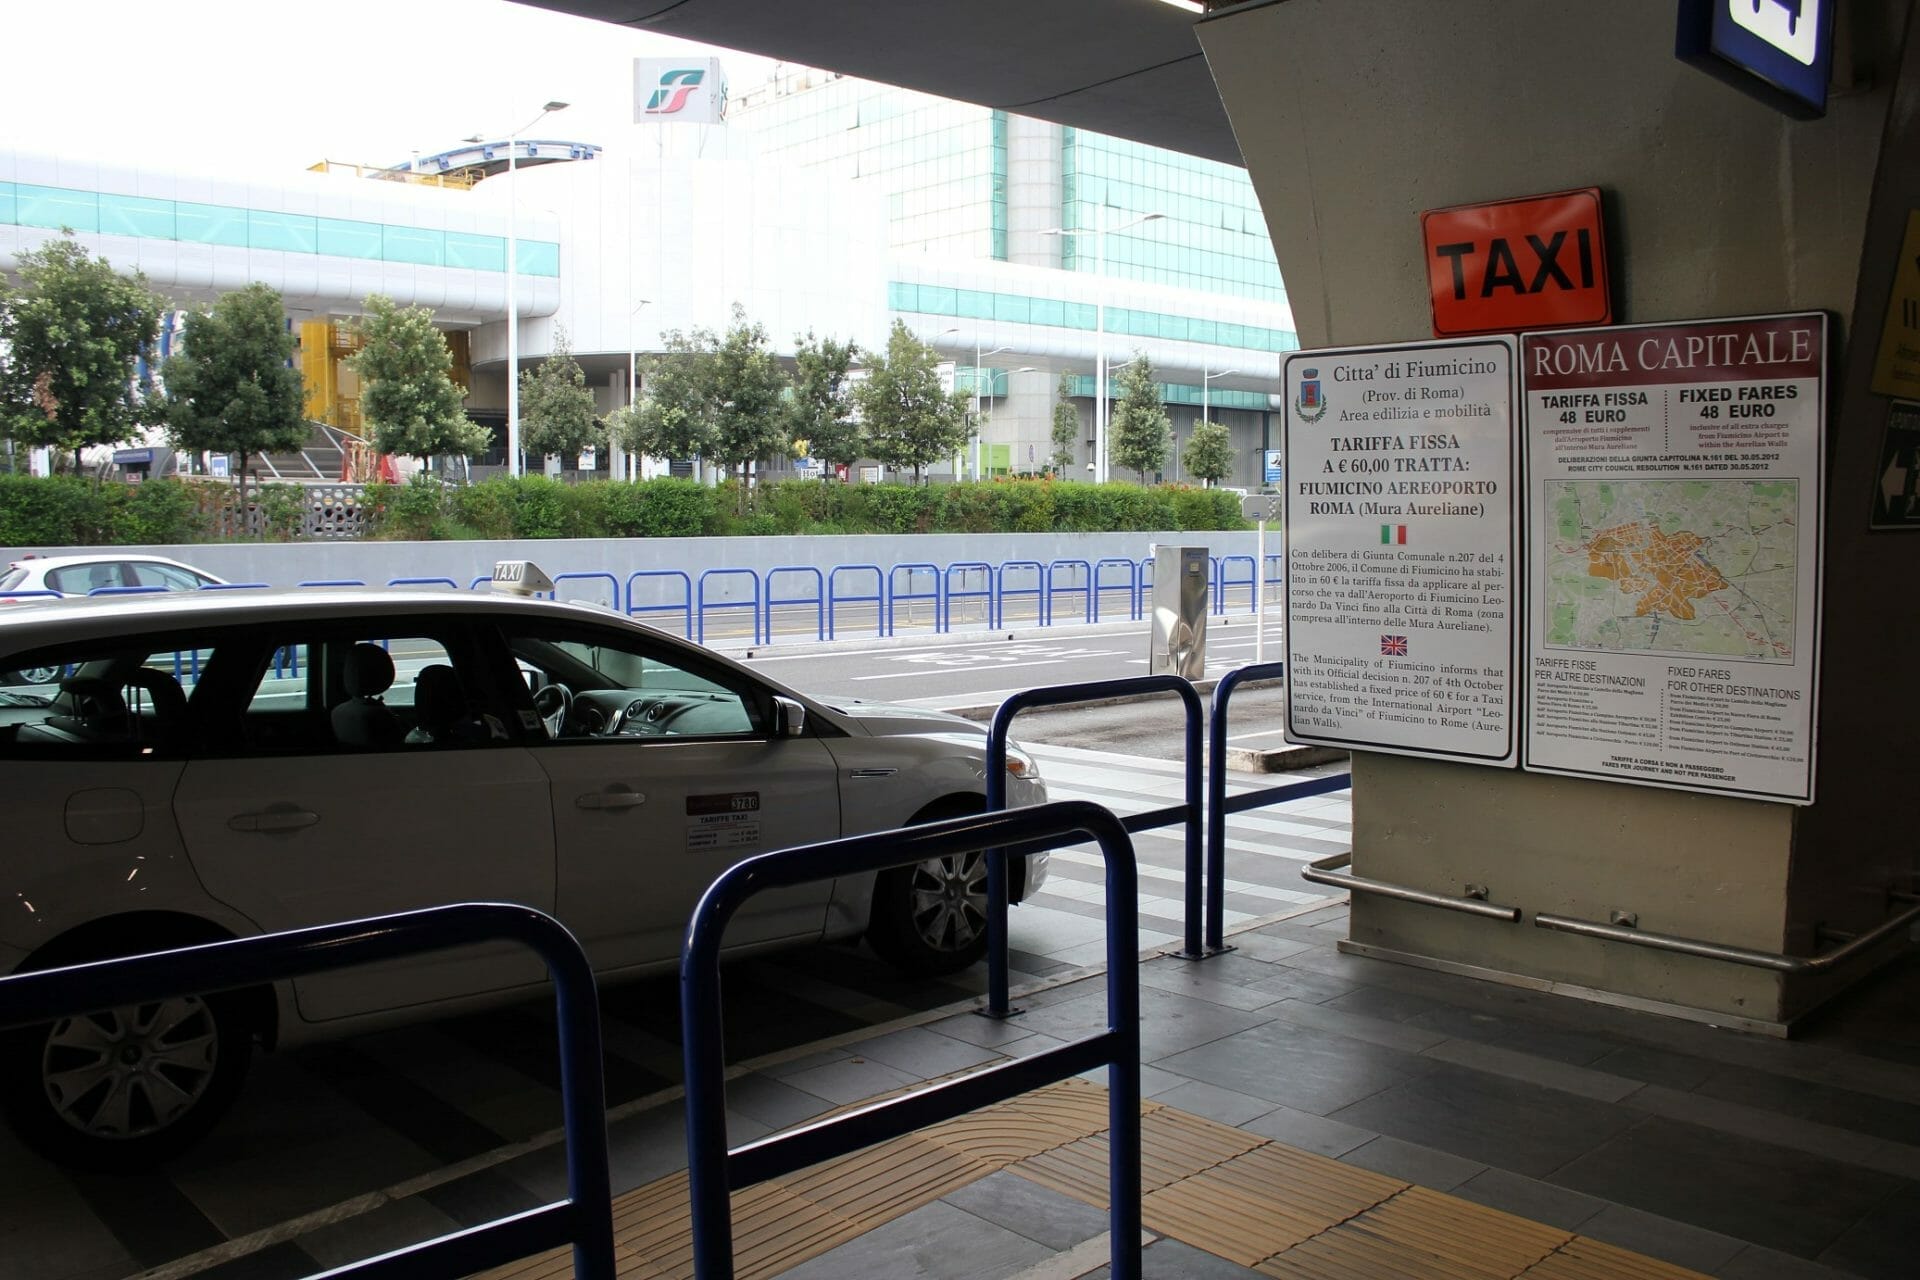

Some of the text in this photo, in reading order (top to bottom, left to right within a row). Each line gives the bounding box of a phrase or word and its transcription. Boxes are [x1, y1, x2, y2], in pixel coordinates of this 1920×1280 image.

[1436, 228, 1594, 301] TAXI
[1533, 330, 1811, 375] ROMA CAPITALE
[1384, 362, 1400, 378] di
[1405, 358, 1496, 377] Fiumicino
[1362, 386, 1464, 403] (Prov. di Roma)
[1541, 392, 1648, 408] TARIFFA FISSA
[1680, 385, 1797, 402] FIXED FARES
[1339, 403, 1491, 421] Area edilizia e mobilità
[1559, 409, 1626, 423] 48 EURO
[1700, 403, 1775, 418] 48 EURO
[1331, 434, 1460, 451] TARIFFA FISSA
[1322, 457, 1469, 474] A € 60,00 TRATTA:
[1300, 481, 1496, 494] FIUMICINO AEREOPORTO
[1310, 501, 1484, 517] ROMA (Mura Aureliane)
[1291, 548, 1503, 563] Con delibera di Giunta Comunale n.207 del 4
[495, 564, 522, 580] TAXI
[1291, 561, 1324, 571] Ottobre
[1326, 562, 1349, 572] 2006,
[1352, 563, 1357, 572] il
[1360, 563, 1397, 573] Comune
[1400, 564, 1408, 573] di
[1411, 565, 1459, 575] Fiumicino
[1462, 566, 1474, 575] ha
[1292, 574, 1306, 583] lito
[1309, 574, 1317, 583] in
[1320, 575, 1330, 584] 60
[1333, 575, 1338, 584] €
[1341, 575, 1349, 585] la
[1353, 576, 1381, 585] tariffa
[1384, 577, 1404, 586] fissa
[1408, 578, 1419, 587] da
[1422, 579, 1467, 590] applicare
[1471, 580, 1480, 590] al
[1316, 588, 1331, 597] che
[1417, 592, 1426, 601] di
[1430, 592, 1479, 603] Fiumicino
[1292, 600, 1503, 618] nardo Da Vinci fino alla Città di Roma (zona
[1292, 614, 1332, 623] compresa
[1383, 617, 1406, 626] delle
[1409, 618, 1434, 628] Mura
[1436, 620, 1492, 632] Aureliane).
[1292, 653, 1503, 677] The Municipality of Fiumicino informs that
[1535, 657, 1596, 670] TARIFFE FISSE
[1293, 666, 1311, 675] with
[1314, 667, 1324, 676] its
[1327, 668, 1359, 678] Official
[1362, 671, 1399, 682] decision
[1413, 674, 1429, 684] 207
[1432, 676, 1442, 685] of
[1445, 678, 1460, 687] 4th
[1464, 679, 1503, 690] October
[1535, 669, 1645, 686] PER ALTRE DESTINAZIONI
[1668, 666, 1730, 680] FIXED FARES
[1293, 677, 1307, 686] has
[1310, 681, 1358, 691] established
[1369, 684, 1391, 694] fixed
[1395, 687, 1418, 697] price
[1421, 689, 1430, 698] of
[1433, 689, 1444, 699] 60
[1447, 691, 1453, 699] €
[1456, 691, 1469, 701] for
[1481, 693, 1503, 704] Taxi
[1667, 680, 1800, 699] FOR OTHER DESTINATIONS
[1294, 692, 1325, 702] service,
[1329, 693, 1350, 703] from
[1354, 696, 1368, 705] the
[1372, 697, 1432, 711] International
[1437, 703, 1472, 715] Airport
[1294, 704, 1318, 713] nardo
[1321, 705, 1332, 714] da
[1366, 710, 1375, 718] of
[1378, 711, 1424, 723] Fiumicino
[1428, 717, 1437, 725] to
[1440, 715, 1468, 728] Rome
[1294, 715, 1341, 728] lian Walls).
[700, 813, 748, 824] TARIFFE TAXI
